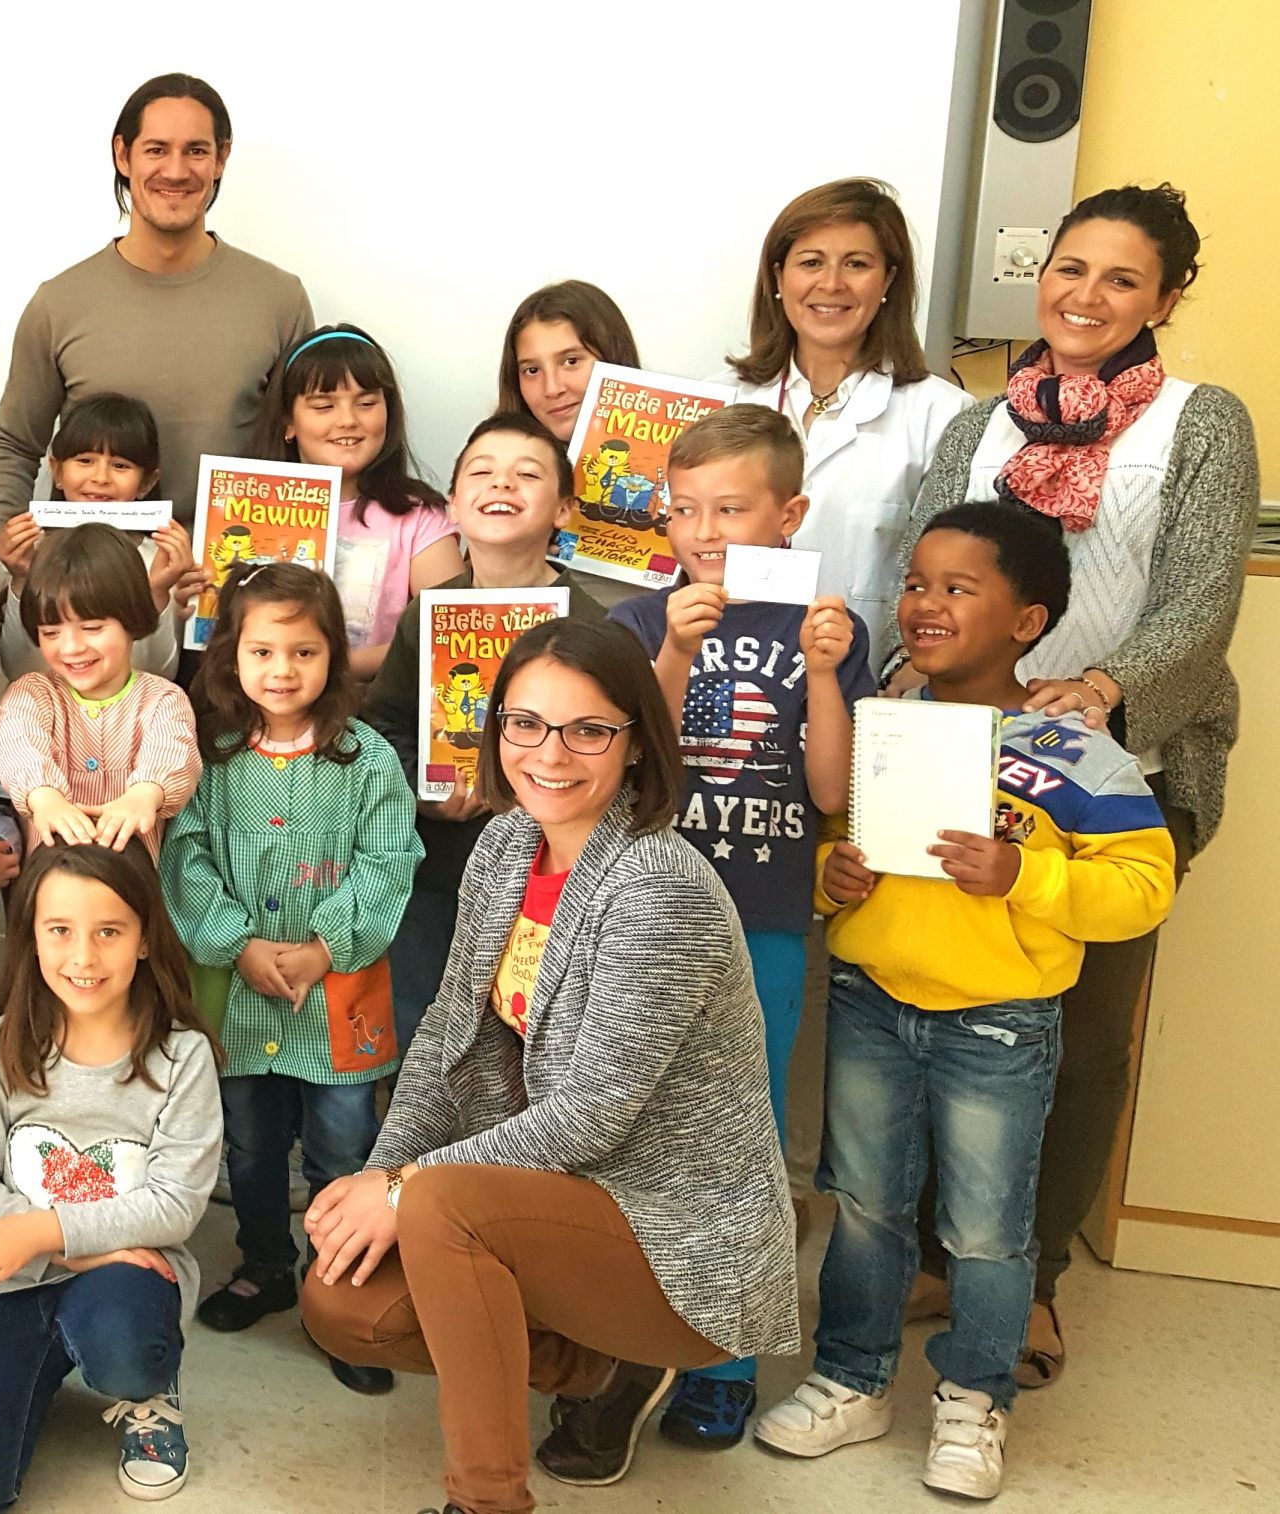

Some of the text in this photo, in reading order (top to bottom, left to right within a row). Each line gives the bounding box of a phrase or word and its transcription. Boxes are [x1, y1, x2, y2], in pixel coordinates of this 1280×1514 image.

[603, 379, 618, 389] Las
[595, 406, 610, 418] de
[599, 383, 717, 422] siete vid
[213, 470, 227, 479] Las
[212, 473, 330, 505] siete vidas
[224, 496, 328, 530] Mawiwi
[434, 605, 448, 613] Las
[434, 607, 496, 632] siete
[435, 632, 450, 645] de
[671, 793, 805, 839] AYERS
